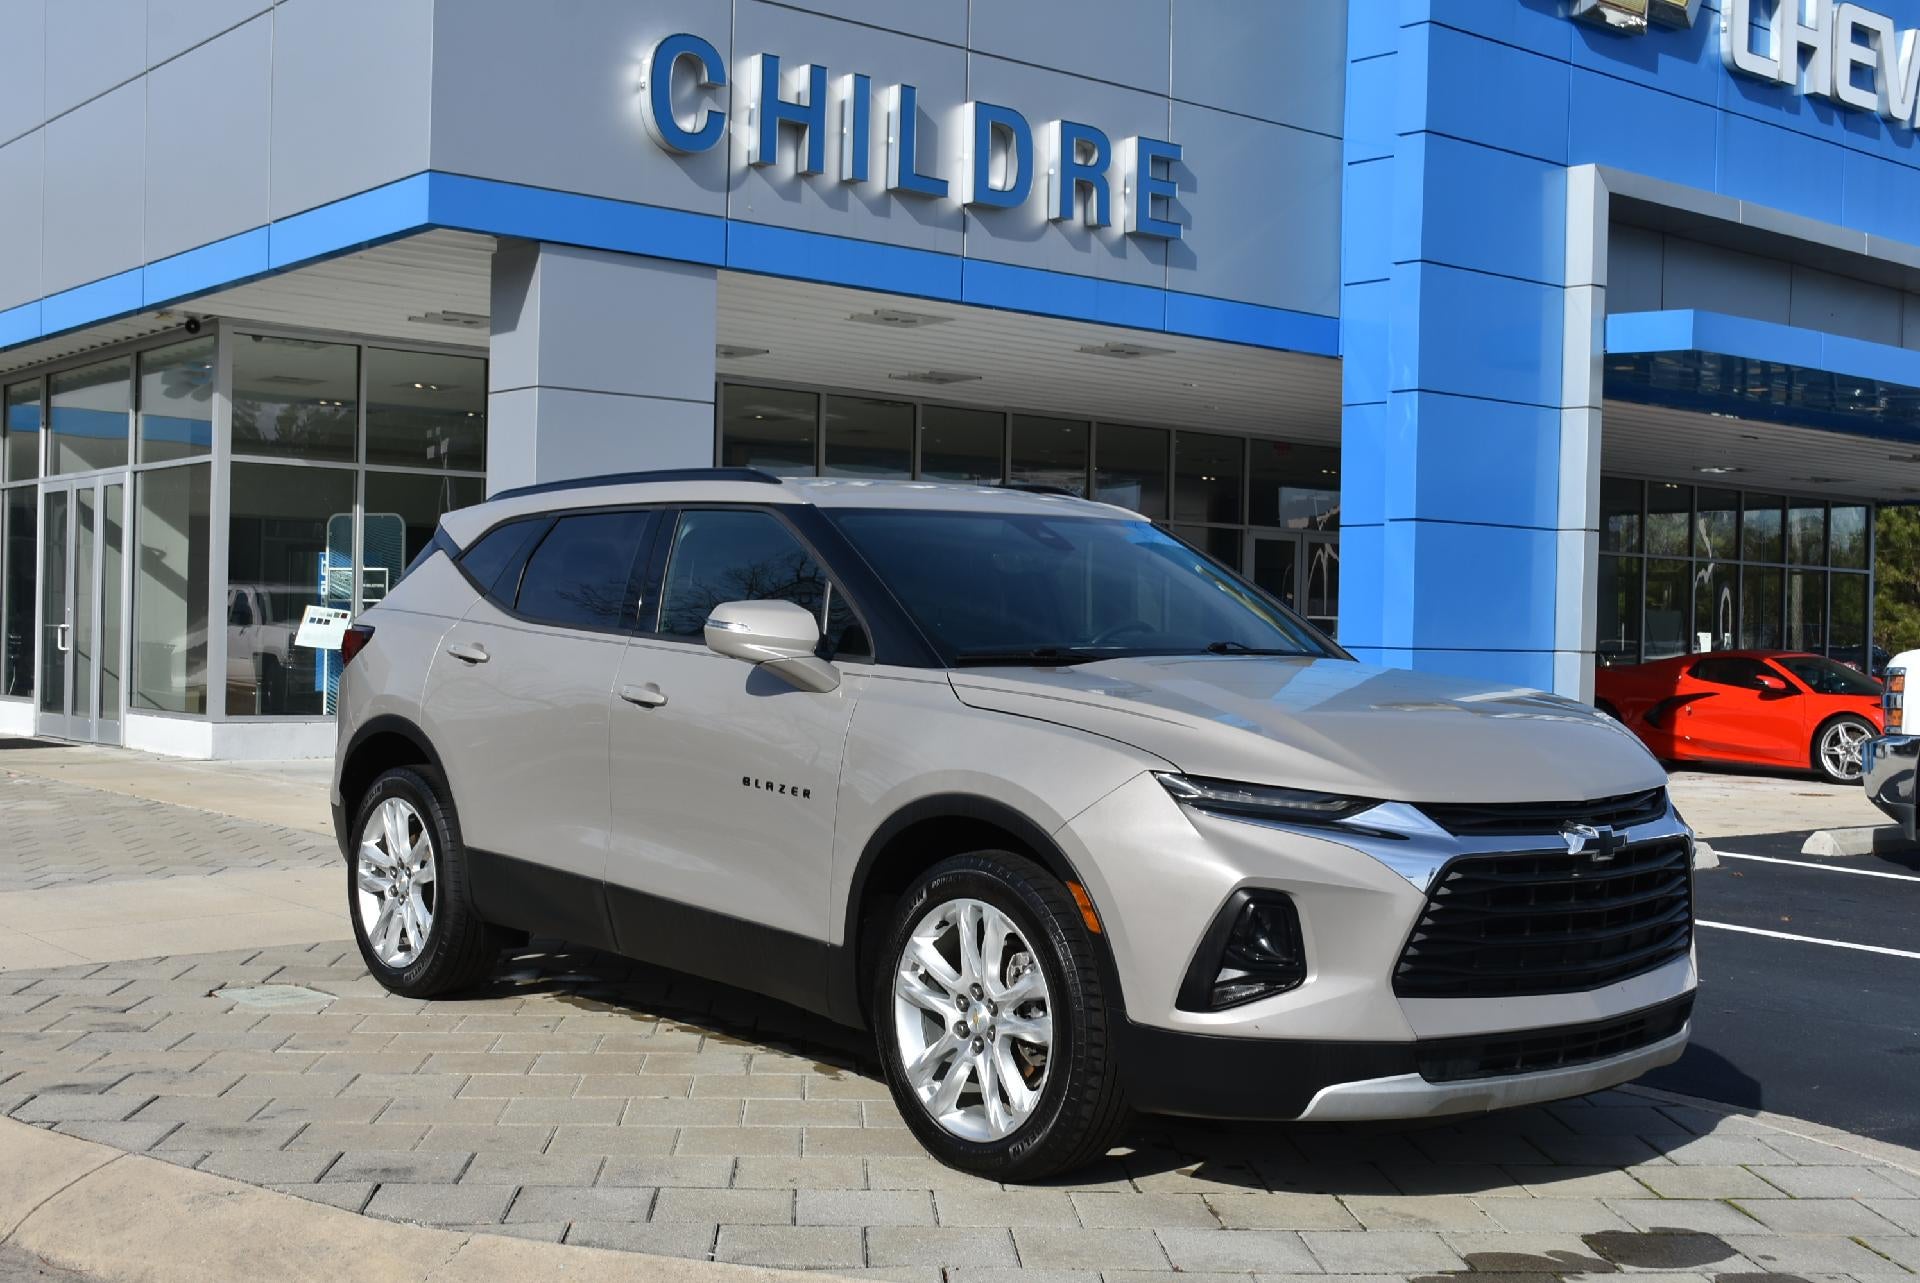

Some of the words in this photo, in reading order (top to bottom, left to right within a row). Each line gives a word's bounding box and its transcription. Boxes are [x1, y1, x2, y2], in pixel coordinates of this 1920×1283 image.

[1721, 0, 1920, 130] CHEV
[642, 32, 1183, 241] CHILDRE
[742, 776, 811, 800] BLAZER
